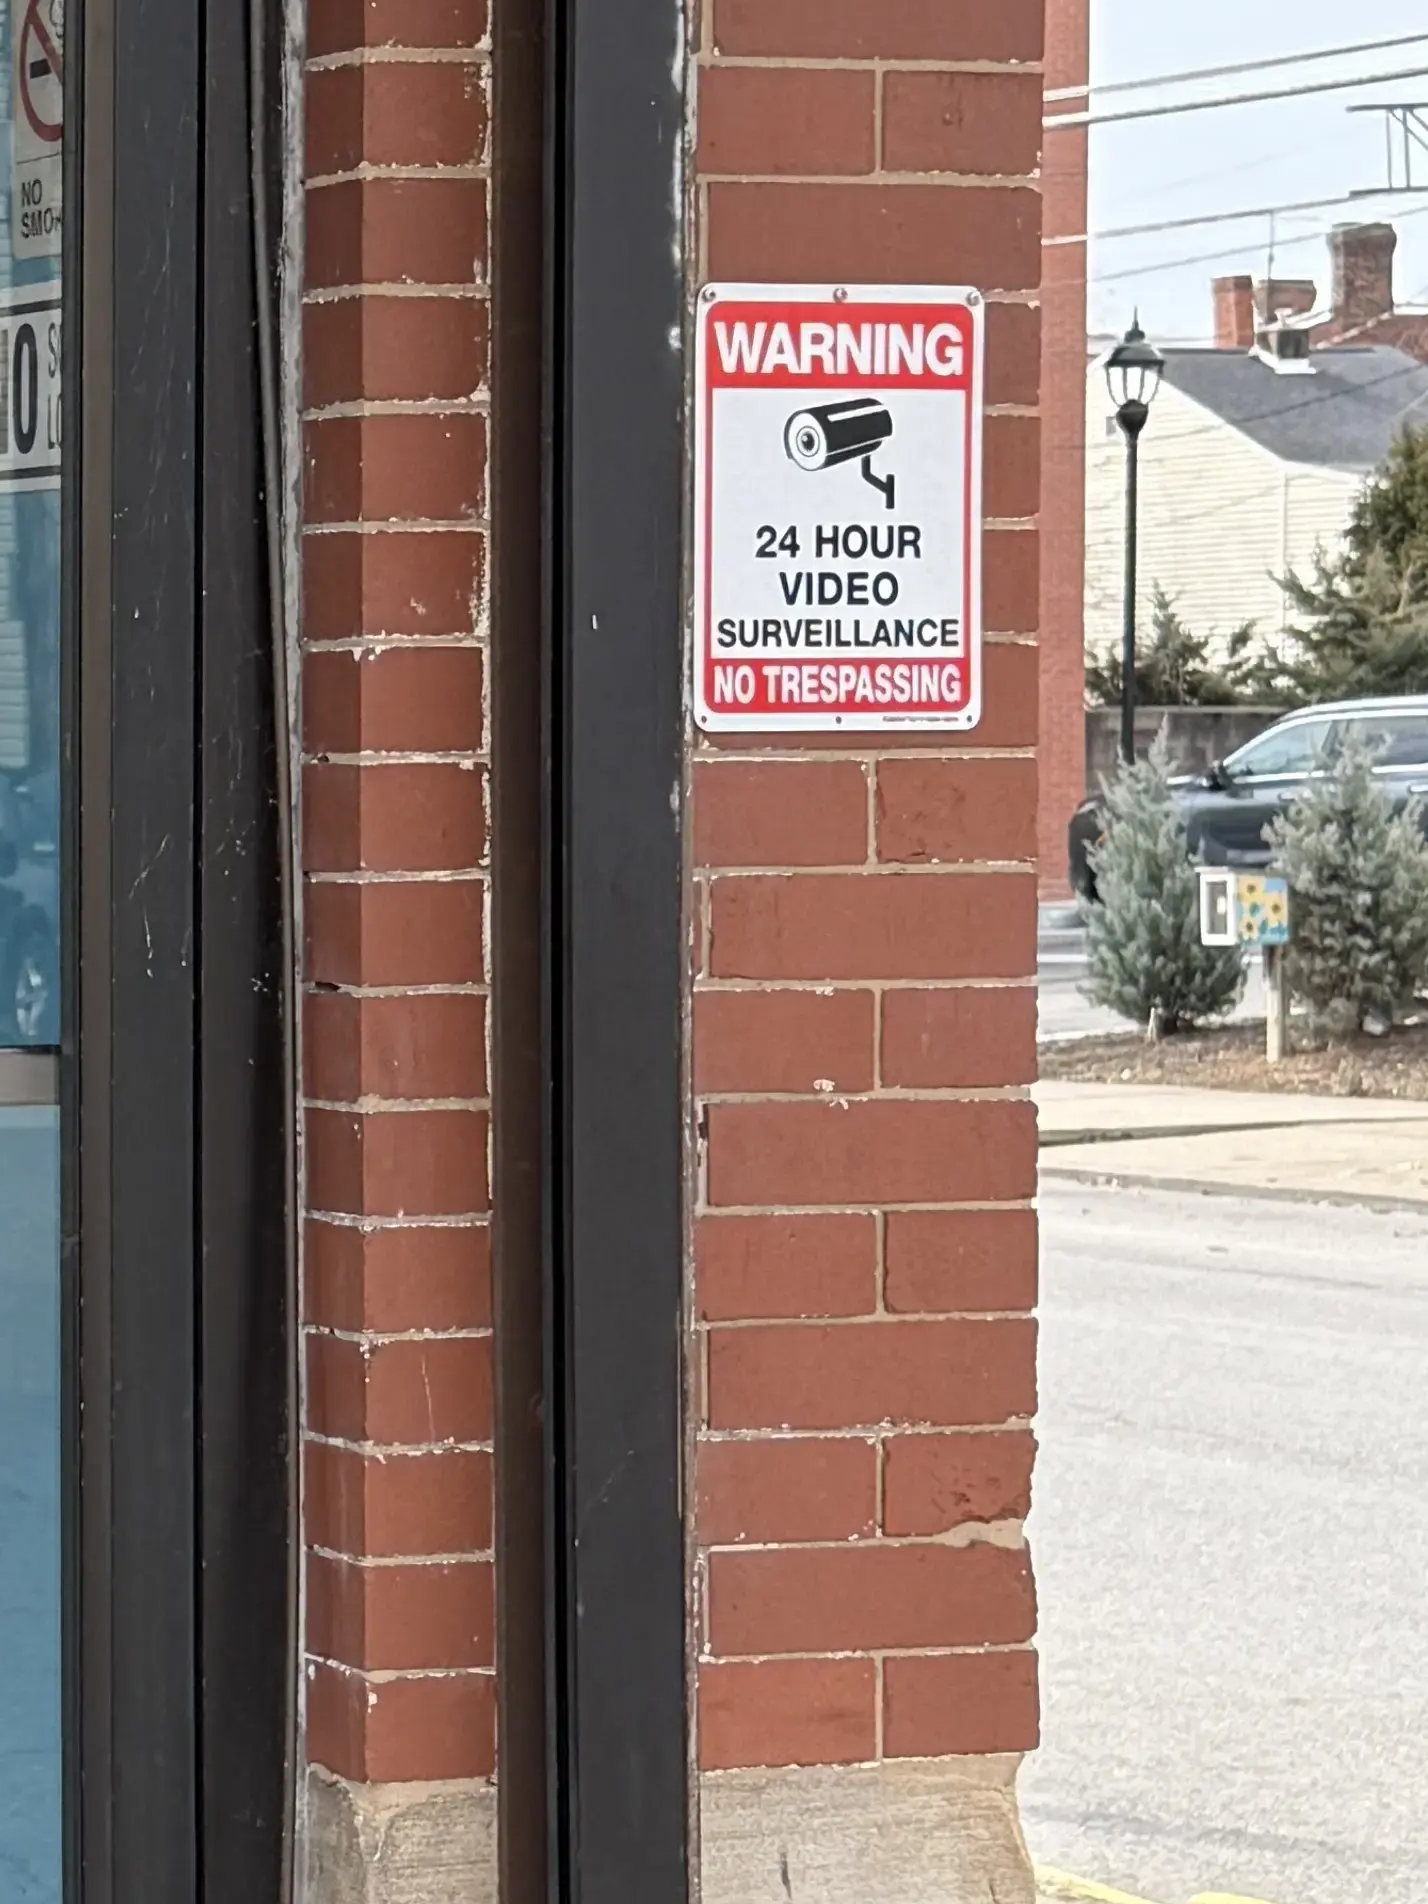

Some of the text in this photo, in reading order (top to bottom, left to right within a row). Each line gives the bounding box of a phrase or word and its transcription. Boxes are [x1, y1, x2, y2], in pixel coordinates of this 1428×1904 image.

[713, 322, 964, 376] WARNING
[755, 525, 922, 559] 24 HOUR
[779, 571, 900, 607] VIDEO
[716, 618, 960, 648] SURVEILLANCE
[713, 663, 962, 705] NO TRESPASSING
